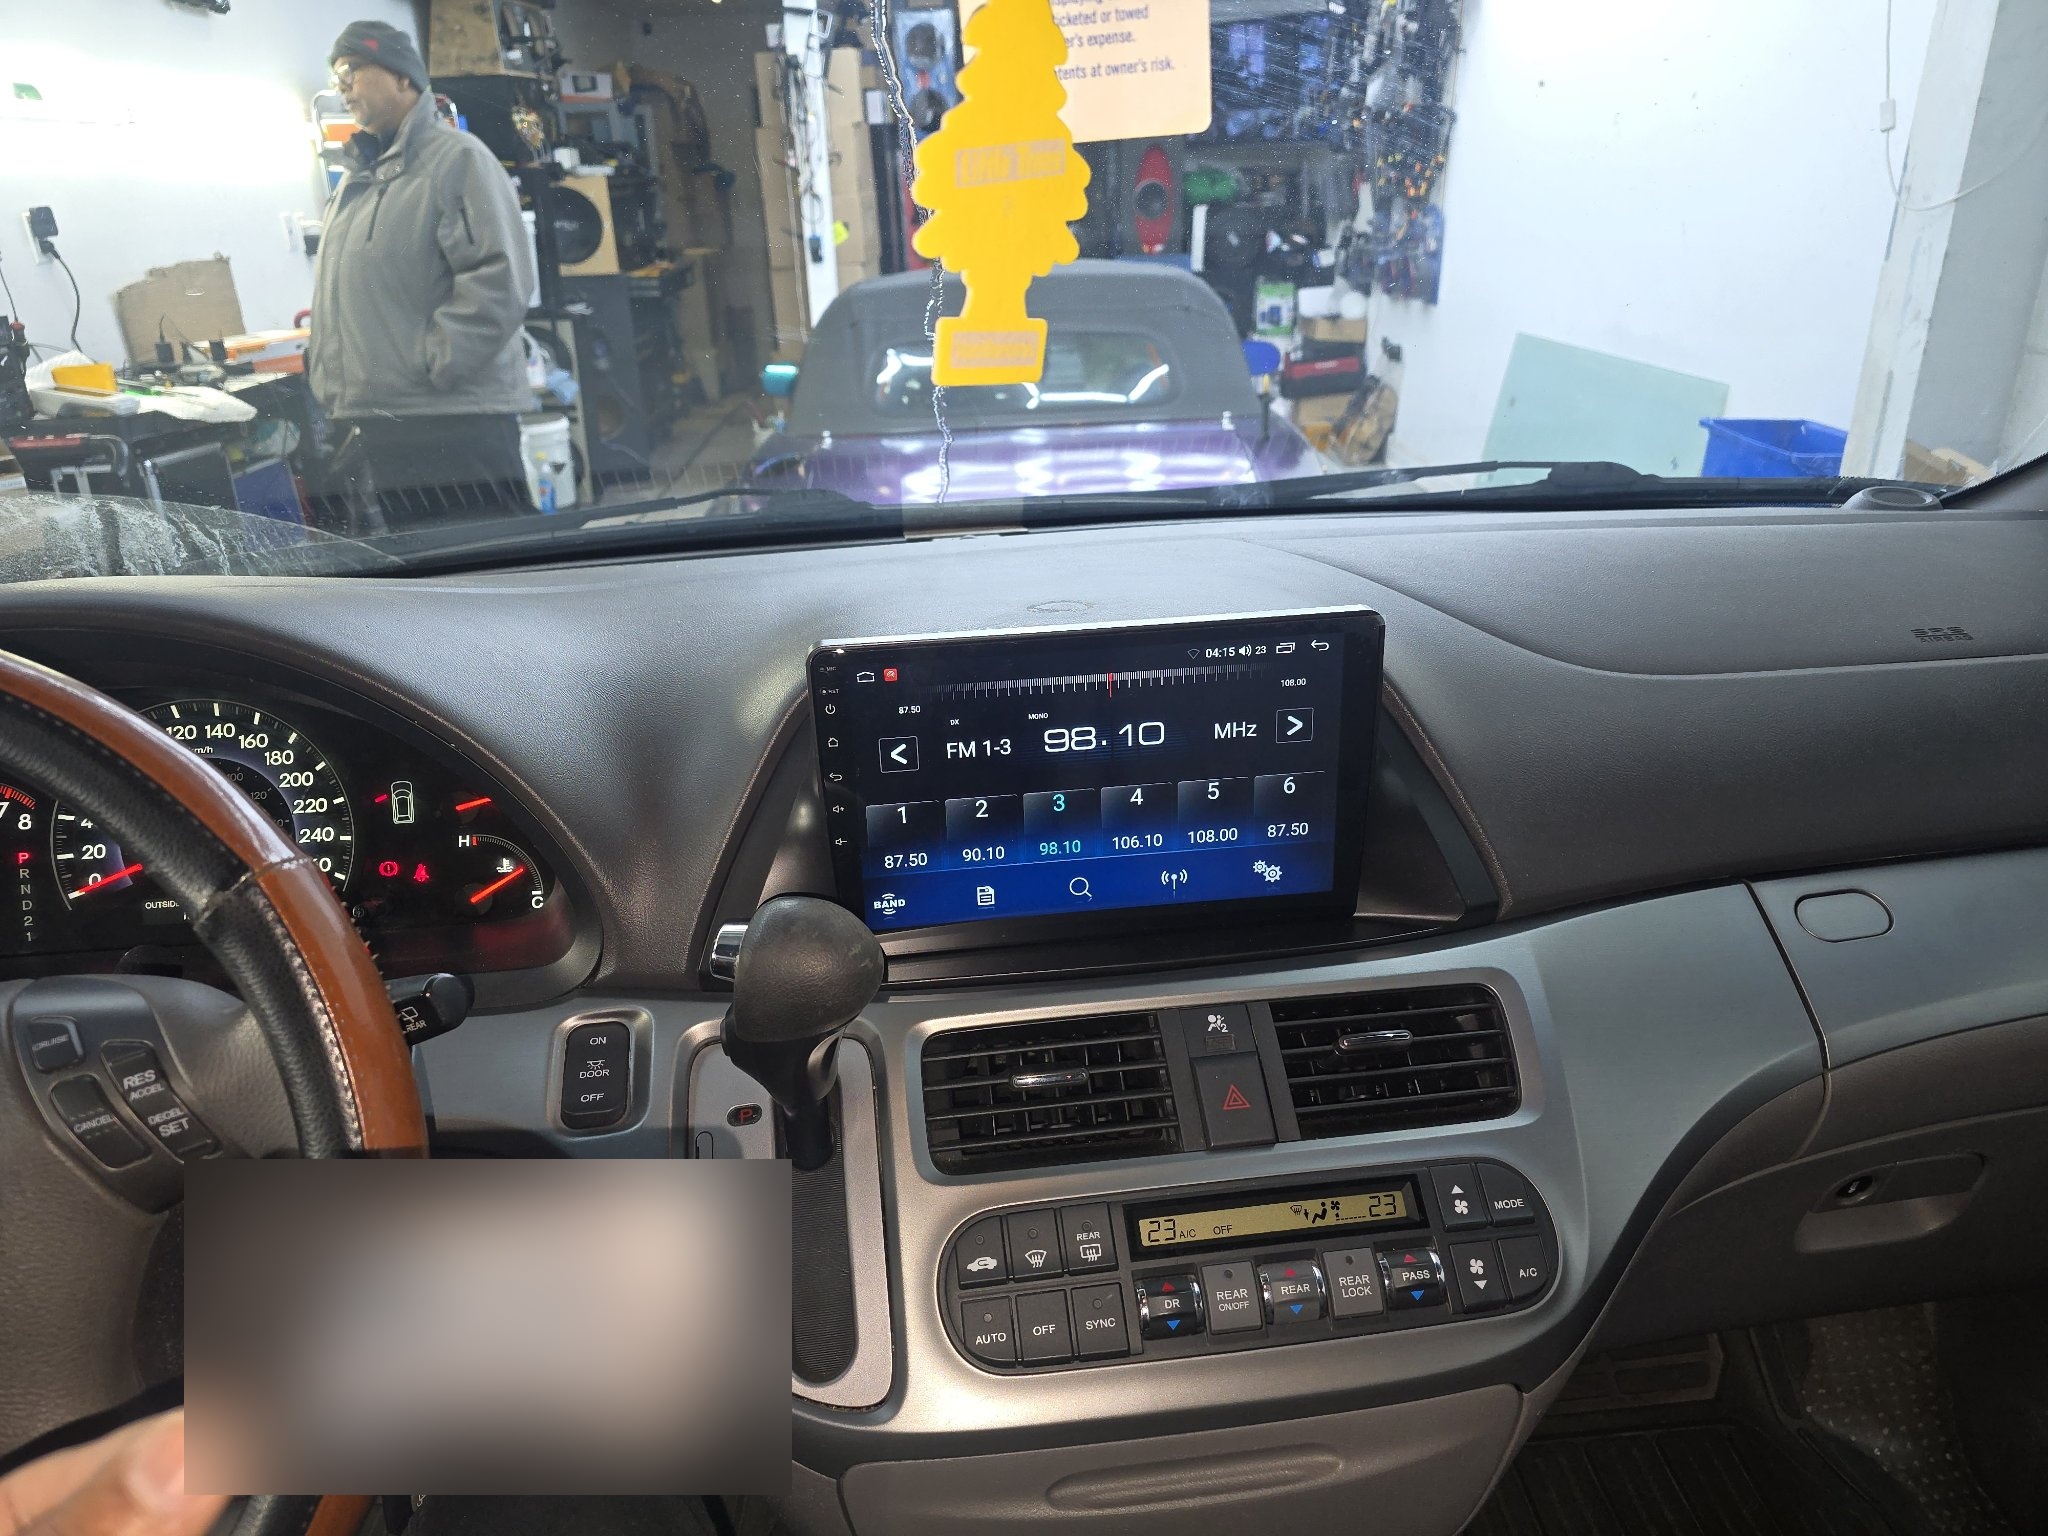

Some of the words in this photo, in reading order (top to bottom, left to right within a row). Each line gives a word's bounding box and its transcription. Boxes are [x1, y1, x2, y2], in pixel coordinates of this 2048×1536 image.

[1101, 11, 1111, 23] or
[1115, 5, 1149, 22] towed
[1087, 30, 1136, 48] expense.
[1090, 63, 1102, 77] at
[1105, 58, 1147, 76] owner's
[1151, 55, 1175, 72] risk.
[1205, 646, 1236, 659] 04:15
[1255, 646, 1267, 655] 23
[1280, 678, 1307, 687] 108.00
[898, 705, 921, 715] 87.50
[1028, 712, 1049, 720] MONO
[950, 718, 960, 726] DX
[204, 723, 236, 739] 140
[1043, 721, 1166, 753] 98.10
[1213, 721, 1258, 740] MHz
[238, 733, 269, 749] 160
[946, 740, 976, 759] FM
[982, 738, 1012, 757] 1-3
[264, 750, 294, 766] 180
[278, 771, 314, 788] 200
[1283, 776, 1296, 794] 6
[1130, 787, 1143, 806] 4
[1207, 781, 1220, 800] 5
[292, 798, 328, 814] 220
[975, 800, 989, 818] 2
[1052, 793, 1065, 811] 3
[17, 813, 32, 830] 8
[897, 806, 907, 823] 1
[299, 827, 335, 843] 240
[1187, 828, 1238, 844] 108.00
[1267, 822, 1309, 838] 87.50
[458, 835, 470, 848] H
[1039, 840, 1081, 855] 98.10
[1112, 833, 1163, 850] 106.10
[17, 852, 30, 864] P
[81, 843, 106, 860] 20
[962, 846, 1005, 862] 90.10
[884, 853, 928, 869] 87.50
[19, 868, 30, 879] R
[20, 884, 31, 895] N
[22, 900, 33, 911] D
[531, 896, 544, 909] C
[873, 898, 906, 910] BAND
[24, 916, 34, 927] 2
[26, 932, 32, 942] 1
[405, 1019, 428, 1033] REAR
[589, 1036, 607, 1045] ON
[122, 1069, 157, 1090] RES
[579, 1068, 610, 1079] DOOR
[580, 1092, 605, 1103] OFF
[73, 1113, 114, 1134] CANCEL
[158, 1117, 190, 1138] SET
[1368, 1193, 1397, 1218] 23
[1494, 1198, 1525, 1210] MODE
[1076, 1231, 1101, 1241] REAR
[1147, 1218, 1177, 1243] 23
[1179, 1228, 1197, 1240] A/C
[1213, 1224, 1233, 1235] OFF
[1402, 1269, 1431, 1281] PASS
[1518, 1267, 1538, 1279] A/C
[1338, 1274, 1370, 1287] REAR
[1216, 1288, 1248, 1301] REAR
[1280, 1283, 1310, 1295] REAR
[1341, 1285, 1372, 1298] LOCK
[1164, 1298, 1180, 1309] DR
[1218, 1301, 1250, 1312] ON/OFF
[1032, 1324, 1056, 1336] OFF
[1085, 1317, 1116, 1331] SYNC
[975, 1332, 1007, 1346] AUTO
